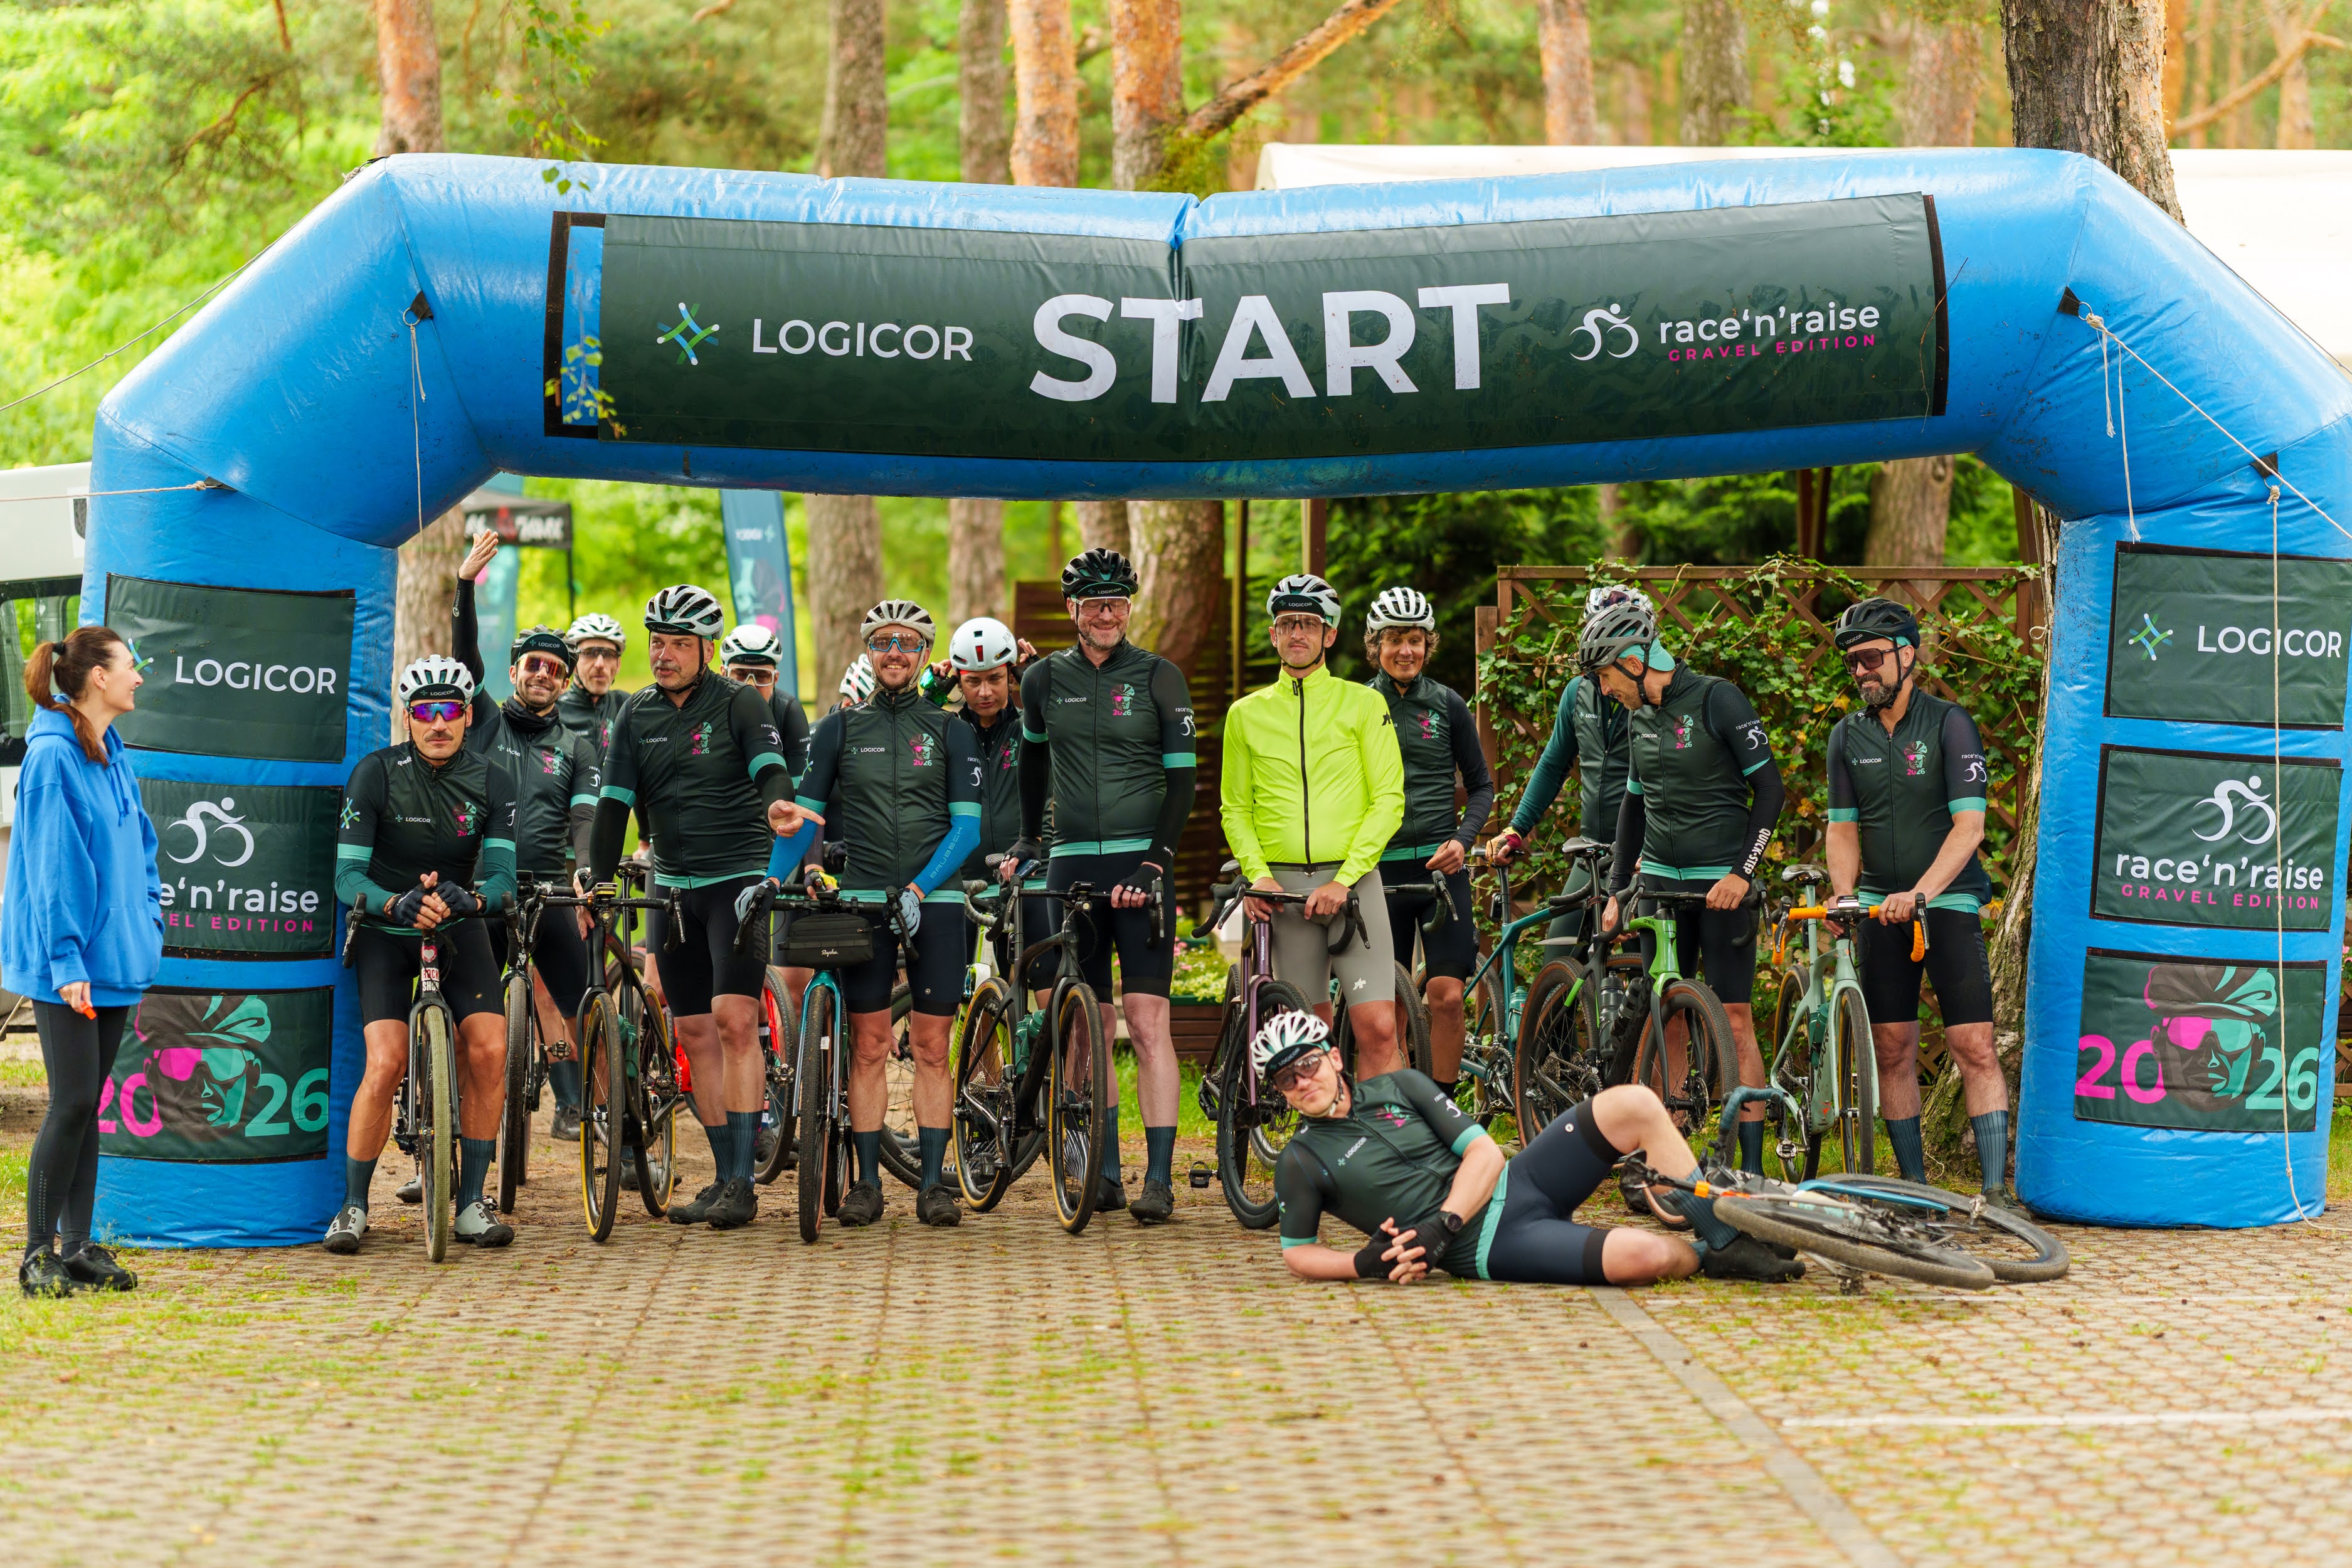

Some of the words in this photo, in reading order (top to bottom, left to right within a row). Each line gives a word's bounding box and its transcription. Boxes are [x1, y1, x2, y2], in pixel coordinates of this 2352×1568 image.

[1660, 302, 1880, 344] race'n'raise
[753, 319, 973, 361] LOGICOR
[1029, 283, 1510, 403] START
[1668, 344, 1761, 362] GRAVEL
[1776, 334, 1876, 354] EDITION
[1845, 633, 1863, 645] LOGICOR
[2197, 625, 2342, 658] LOGICOR
[175, 656, 336, 694] LOGICOR
[1676, 741, 1692, 750] 2026
[544, 767, 561, 776] 2026
[457, 829, 475, 837] 2026
[2116, 854, 2324, 890] race'n'raise
[159, 877, 319, 913] e'n'raise
[2121, 884, 2217, 904] GRAVEL
[211, 916, 314, 933] EDITION
[754, 917, 767, 964] RAPH
[1278, 1047, 1300, 1066] LOGICOR
[2075, 1034, 2167, 1104] 20
[2245, 1047, 2320, 1111] 26
[245, 1068, 329, 1138] 26
[1345, 1136, 1367, 1158] LOGICOR
